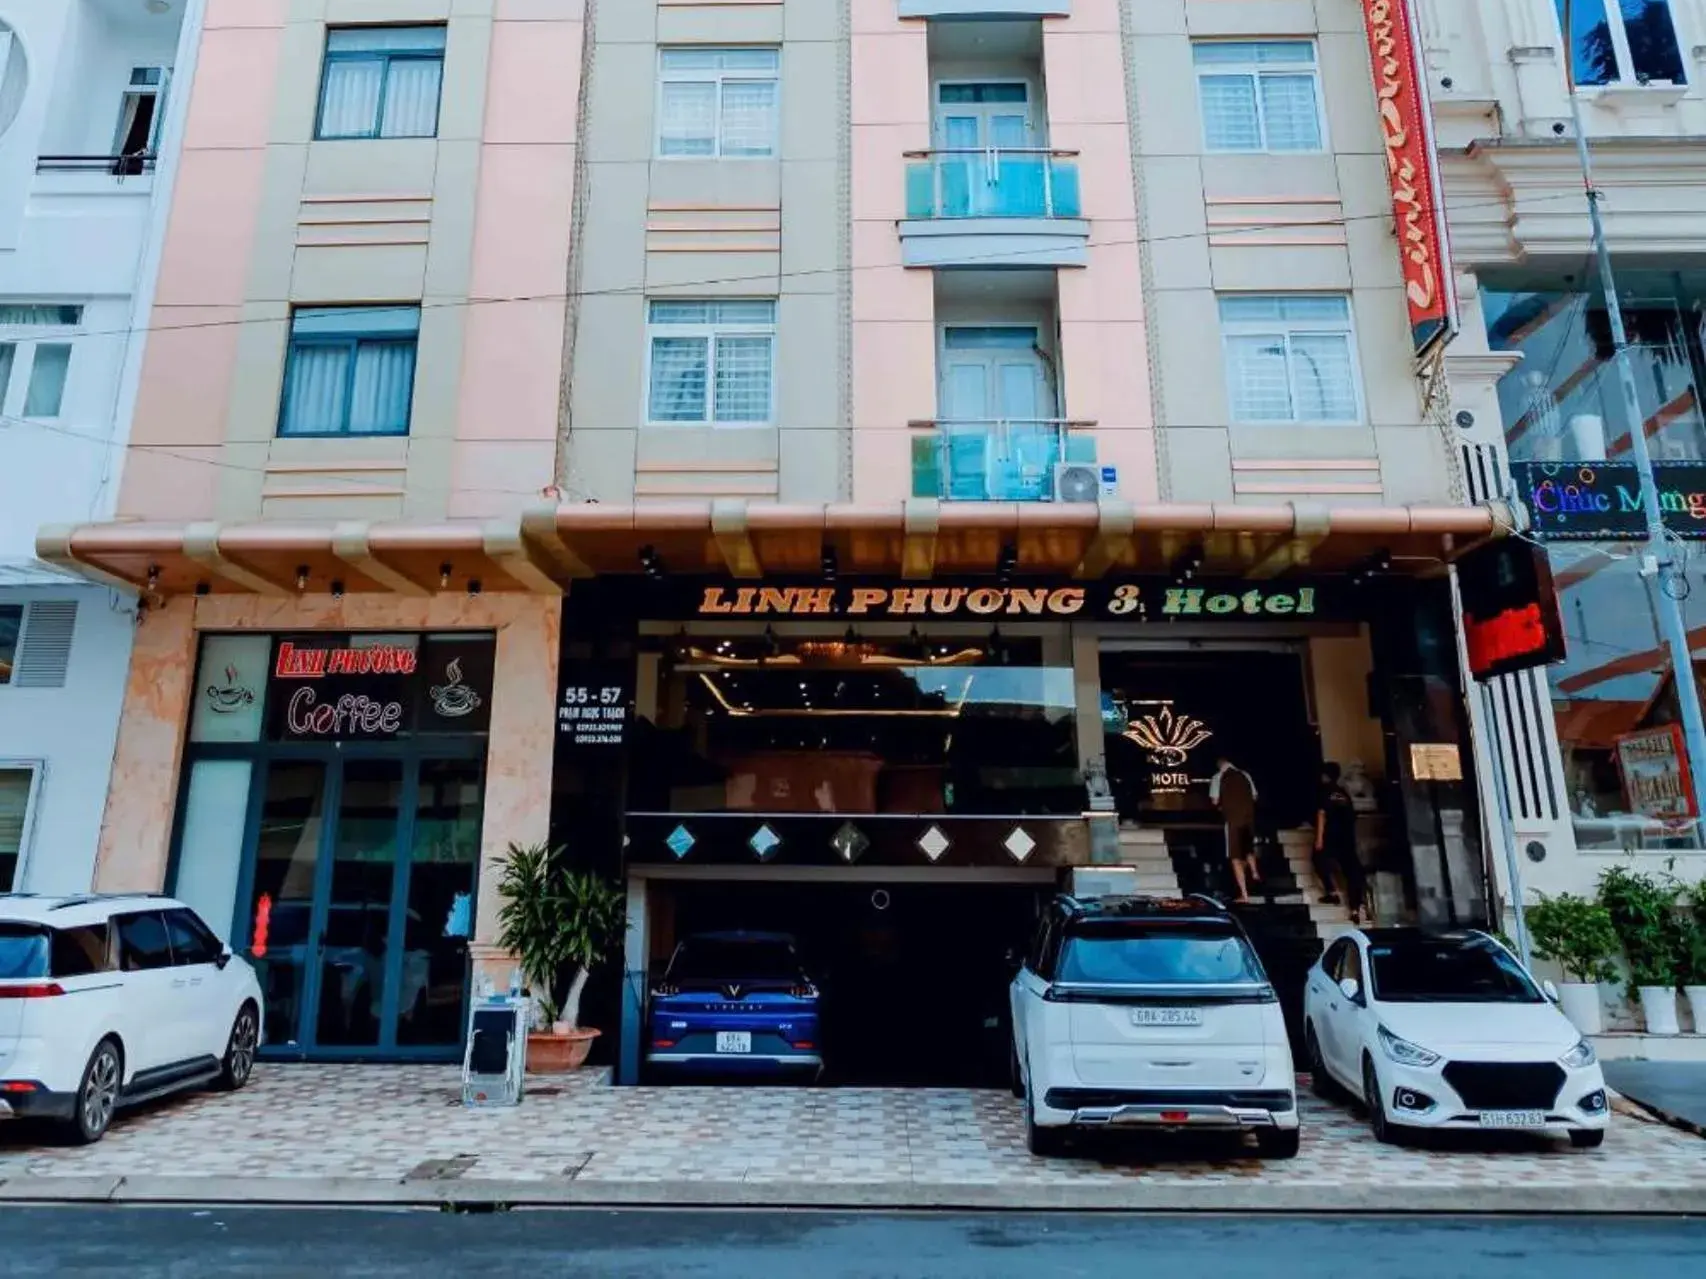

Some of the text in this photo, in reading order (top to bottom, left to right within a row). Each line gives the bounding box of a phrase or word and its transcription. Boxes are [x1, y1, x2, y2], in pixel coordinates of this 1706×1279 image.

[698, 584, 1316, 615] LINH PHƯƠNG 3 Hotel
[565, 687, 588, 704] 55
[600, 687, 622, 704] 57
[287, 686, 401, 733] Coffee
[1151, 773, 1190, 786] HOTEL
